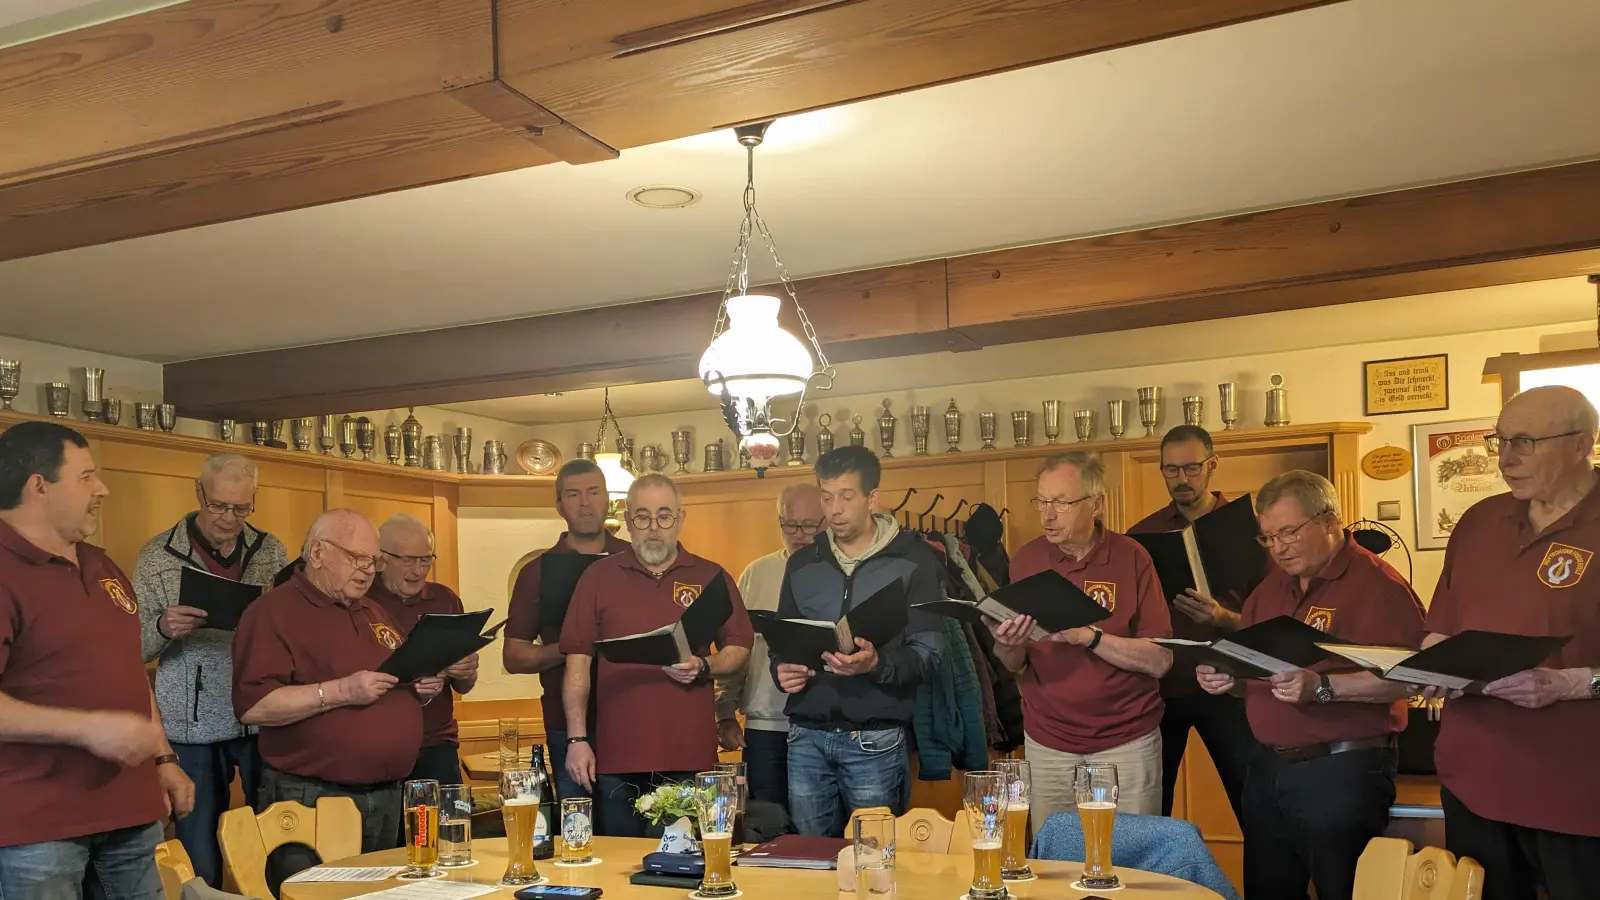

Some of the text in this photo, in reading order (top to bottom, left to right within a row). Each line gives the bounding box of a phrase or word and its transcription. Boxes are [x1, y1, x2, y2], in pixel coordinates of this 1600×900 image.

[1398, 368, 1410, 376] und
[1413, 367, 1429, 375] trink
[1394, 377, 1405, 385] Dir
[1388, 394, 1405, 402] Geld
